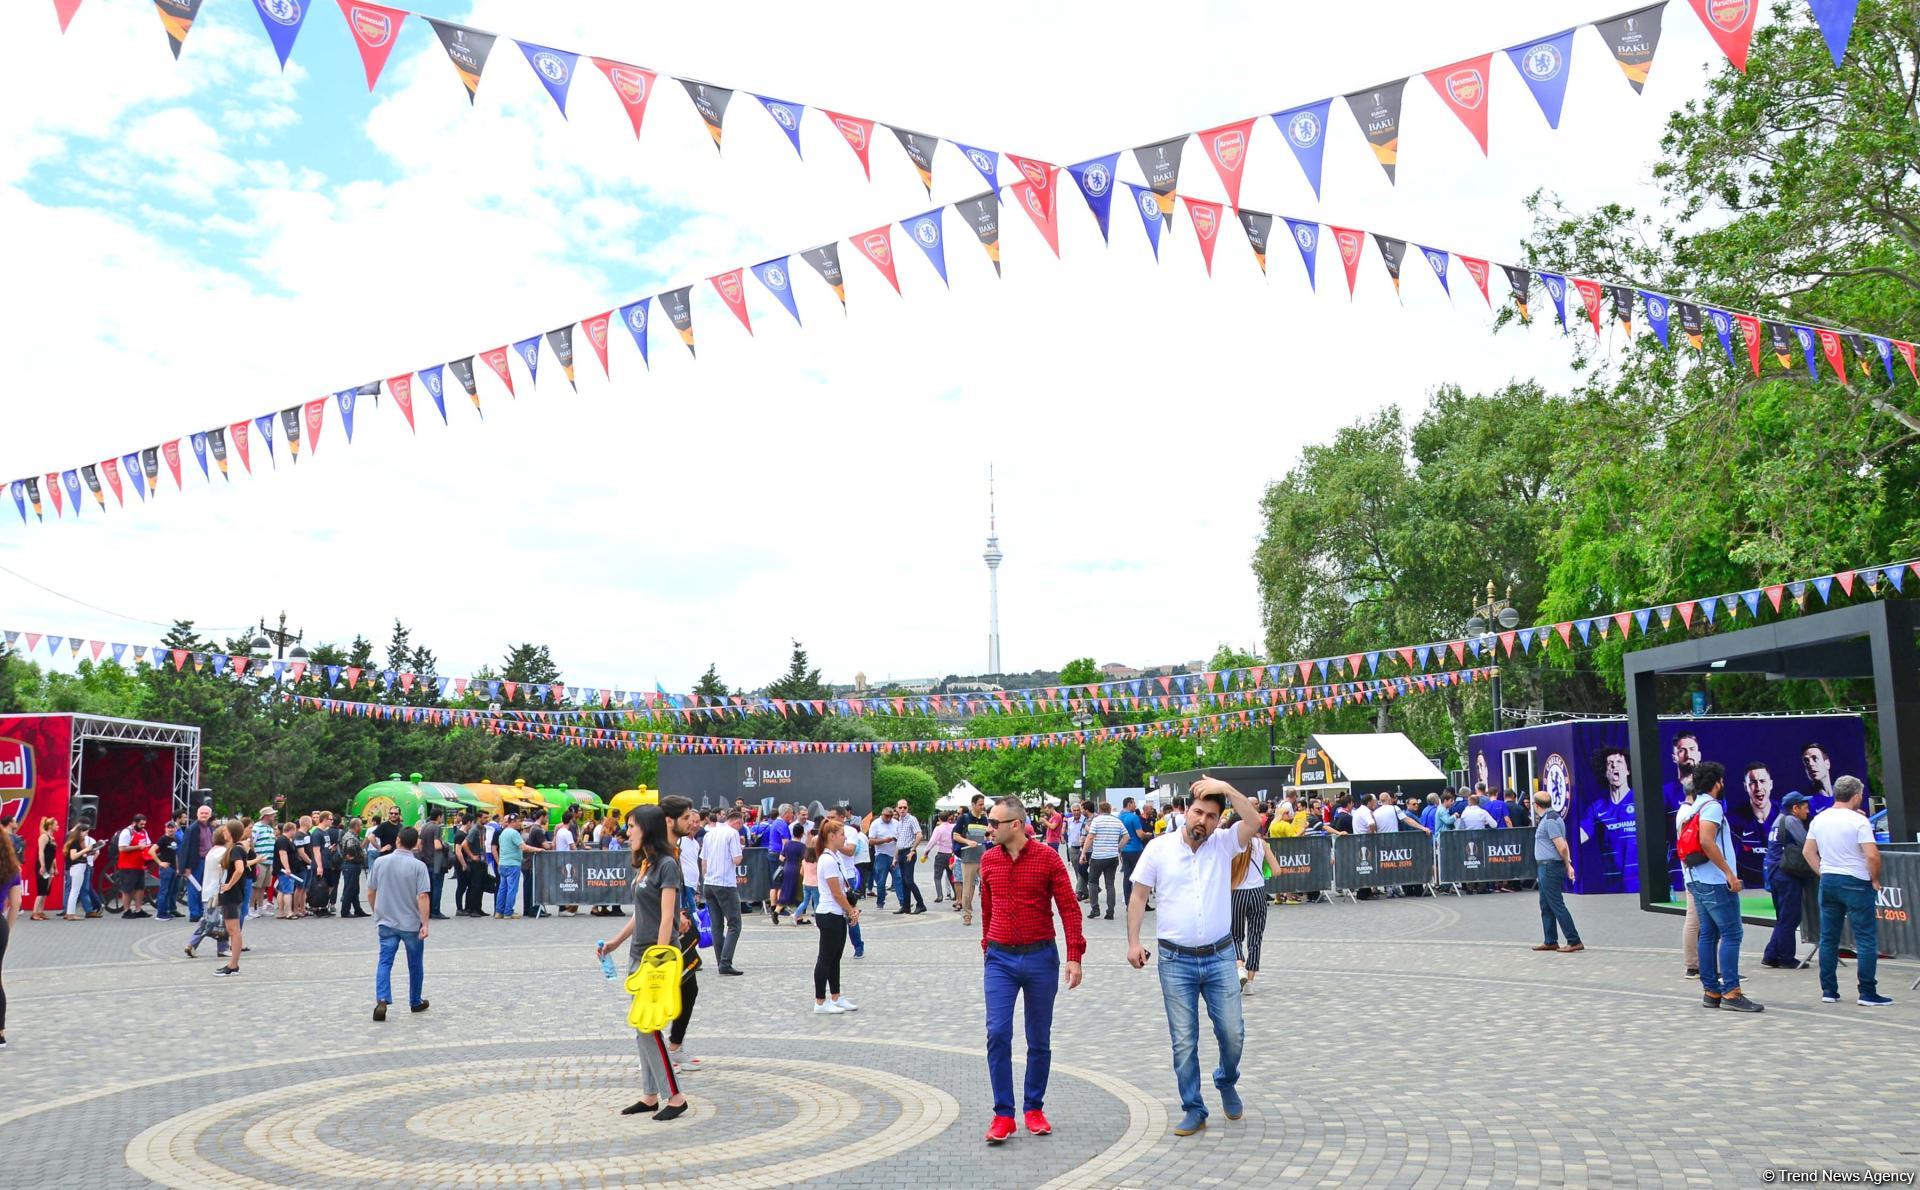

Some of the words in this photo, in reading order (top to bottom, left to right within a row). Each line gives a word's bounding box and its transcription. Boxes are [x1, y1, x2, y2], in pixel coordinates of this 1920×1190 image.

[1617, 43, 1649, 53] BAKU
[1368, 117, 1394, 132] BAKU
[762, 769, 792, 779] BAKU
[1606, 820, 1636, 831] YOKOHAMA
[1379, 848, 1413, 862] BAKU
[1488, 844, 1521, 857] BAKU
[1279, 854, 1311, 867] BAKU
[587, 867, 627, 880] BAKU
[587, 879, 607, 887] FINAL
[609, 879, 627, 887] 2019
[1884, 909, 1907, 921] 2019
